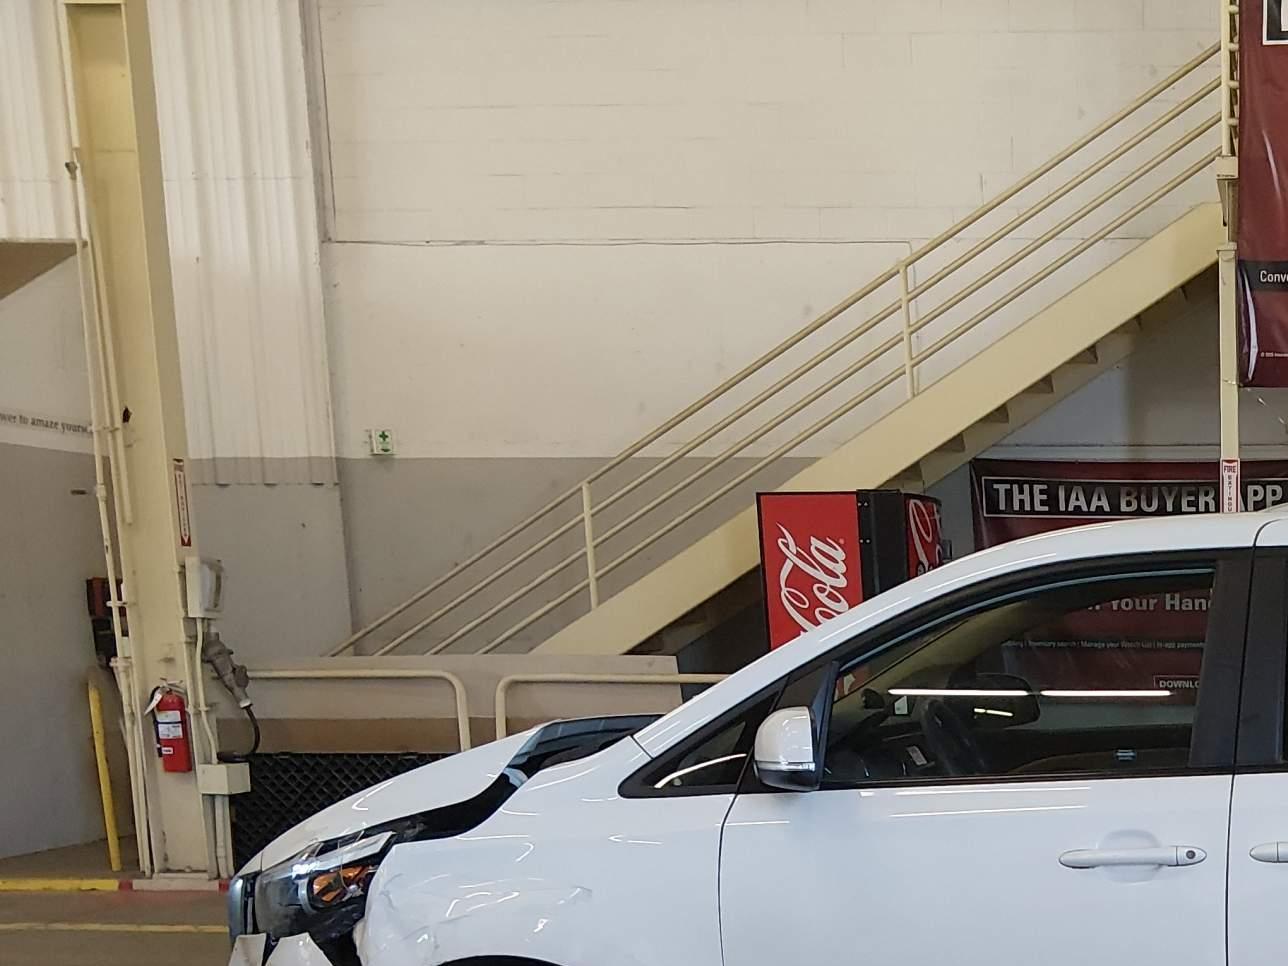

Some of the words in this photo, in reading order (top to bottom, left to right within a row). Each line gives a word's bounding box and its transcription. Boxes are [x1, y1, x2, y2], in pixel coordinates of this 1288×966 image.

[1223, 465, 1237, 473] FIRE
[993, 483, 1049, 512] THE
[1057, 484, 1110, 512] IAA
[1120, 485, 1215, 512] BUYER
[1240, 485, 1283, 511] PP
[776, 522, 849, 632] Cola
